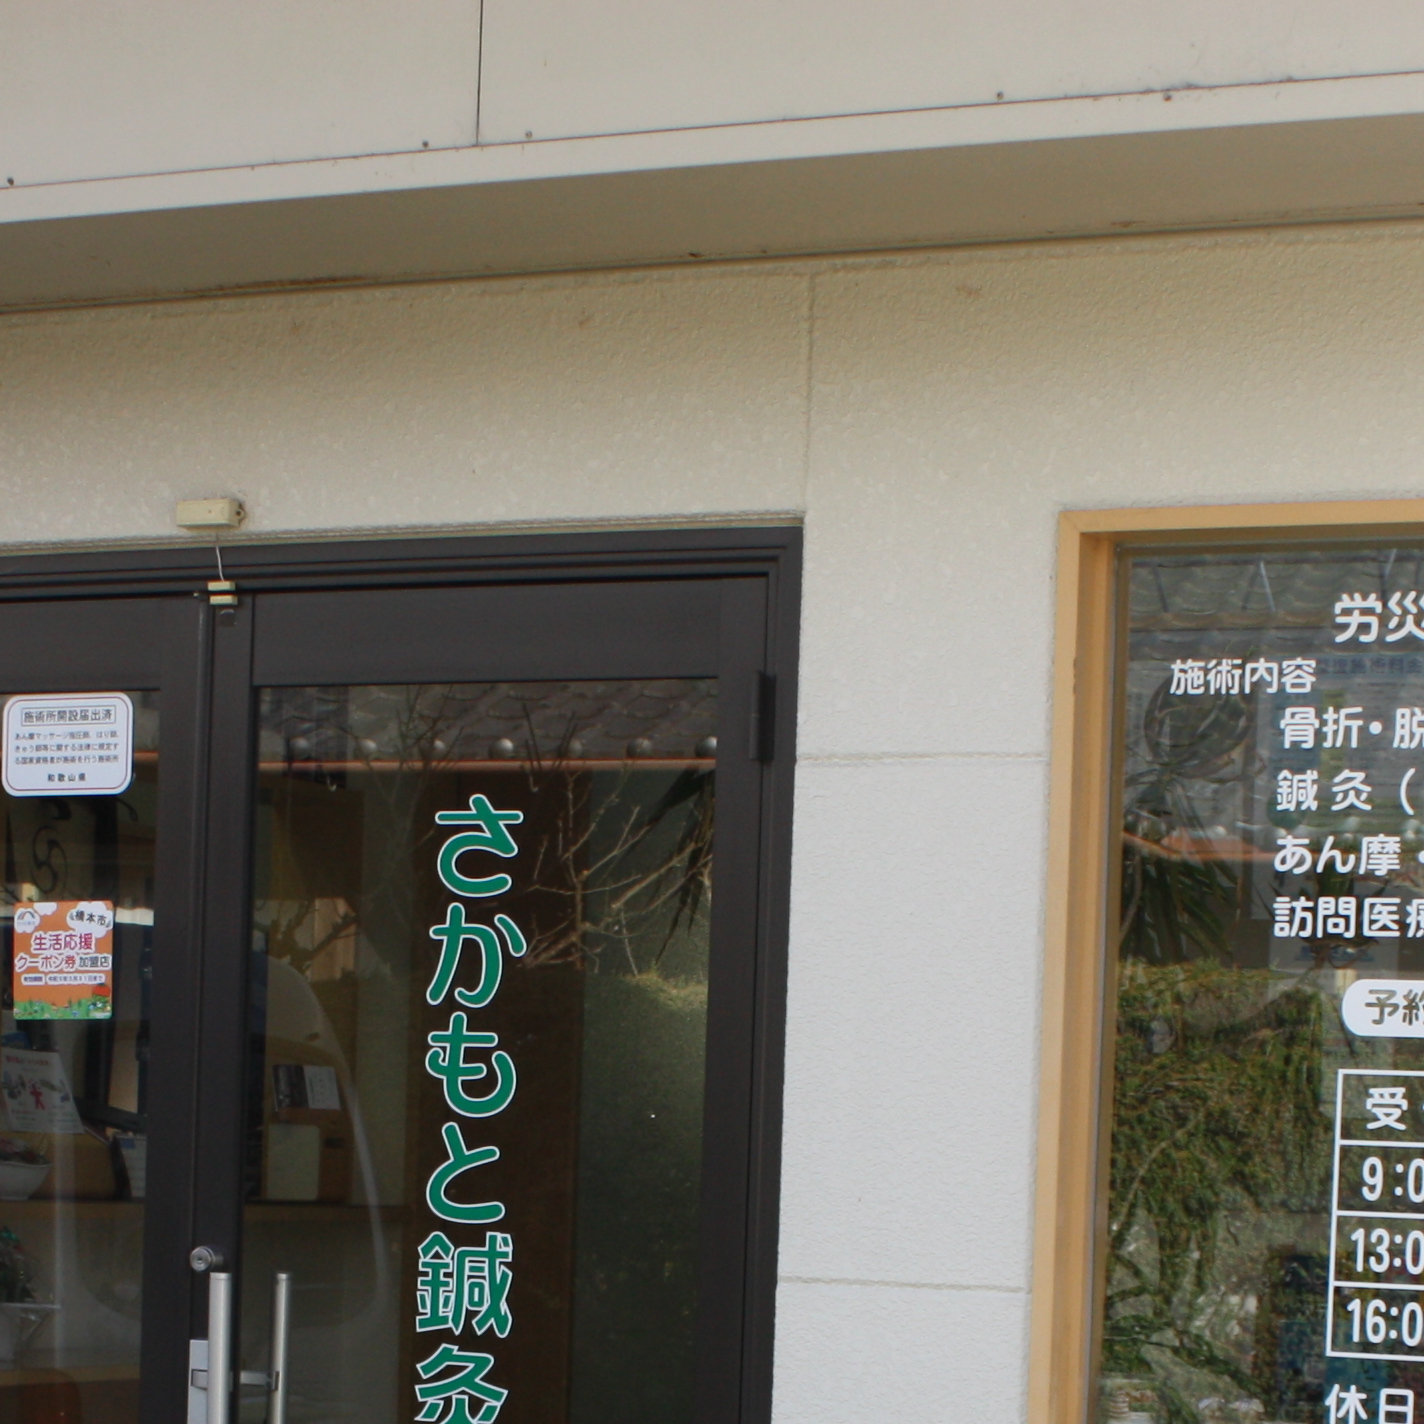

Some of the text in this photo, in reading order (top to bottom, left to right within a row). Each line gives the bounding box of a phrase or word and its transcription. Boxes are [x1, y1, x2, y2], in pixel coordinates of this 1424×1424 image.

[1170, 657, 1317, 695] 施術内容
[33, 933, 94, 951] 生活応援
